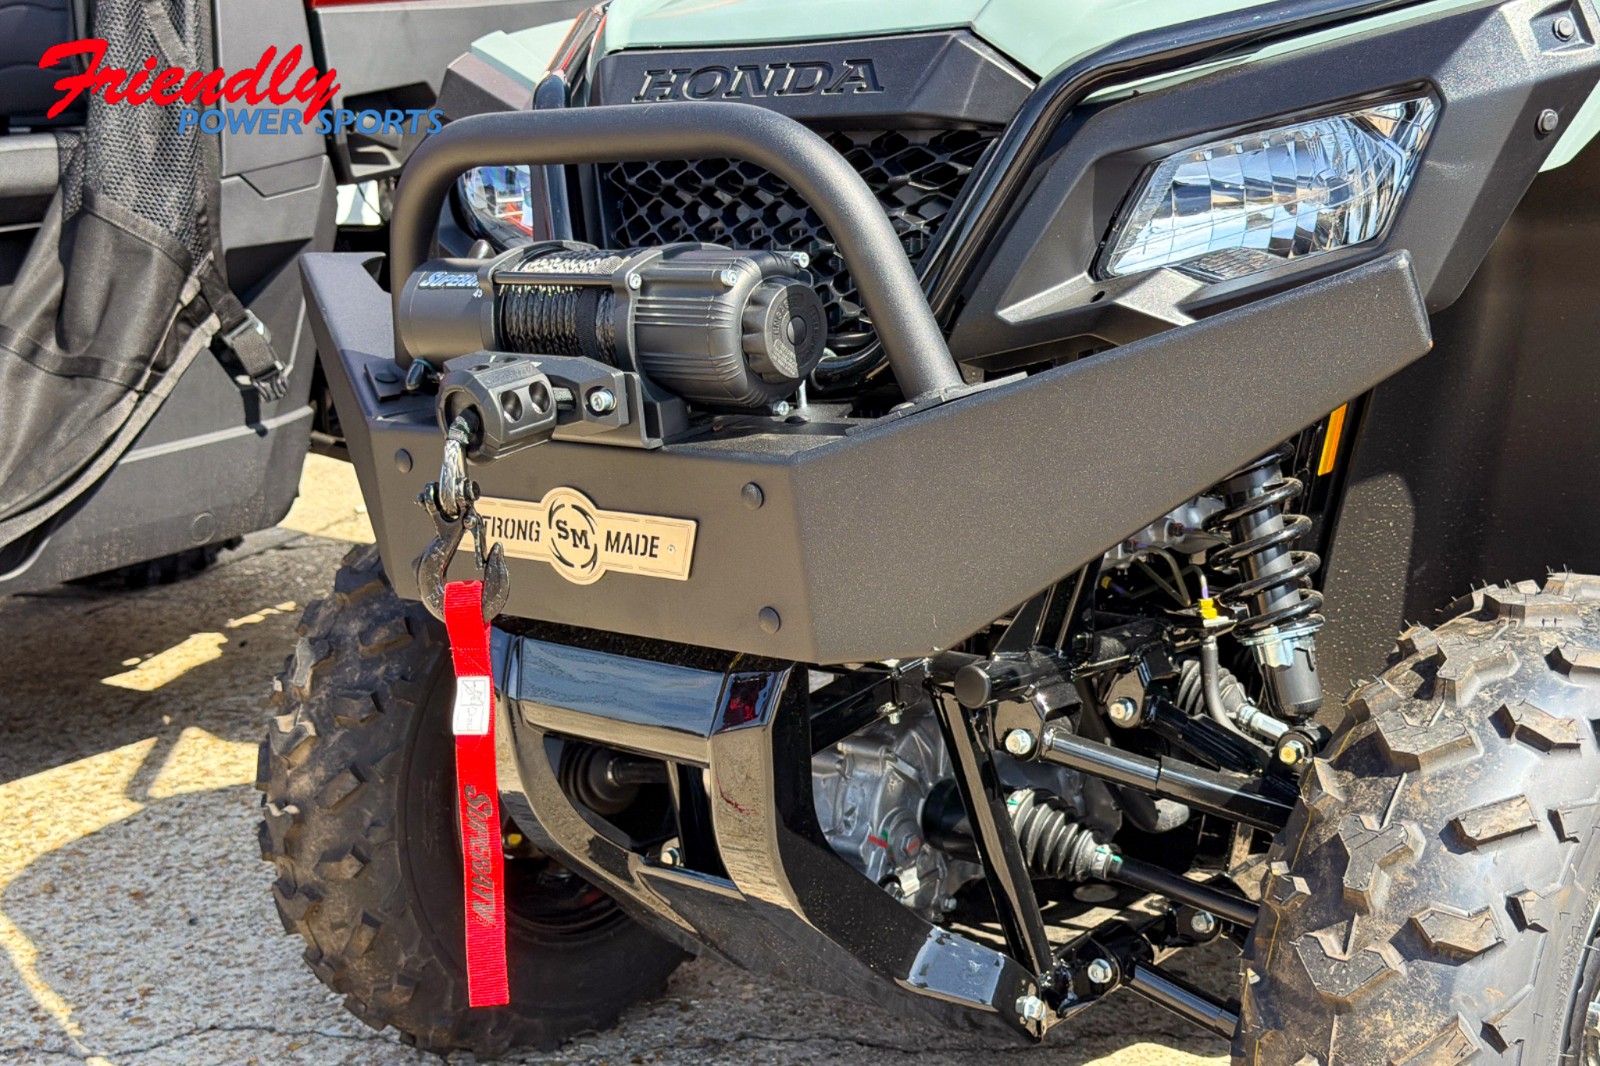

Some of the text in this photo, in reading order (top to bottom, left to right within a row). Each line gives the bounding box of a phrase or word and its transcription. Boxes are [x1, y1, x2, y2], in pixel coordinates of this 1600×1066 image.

[632, 59, 885, 104] HONDA
[483, 515, 661, 558] TRONG SM MADE
